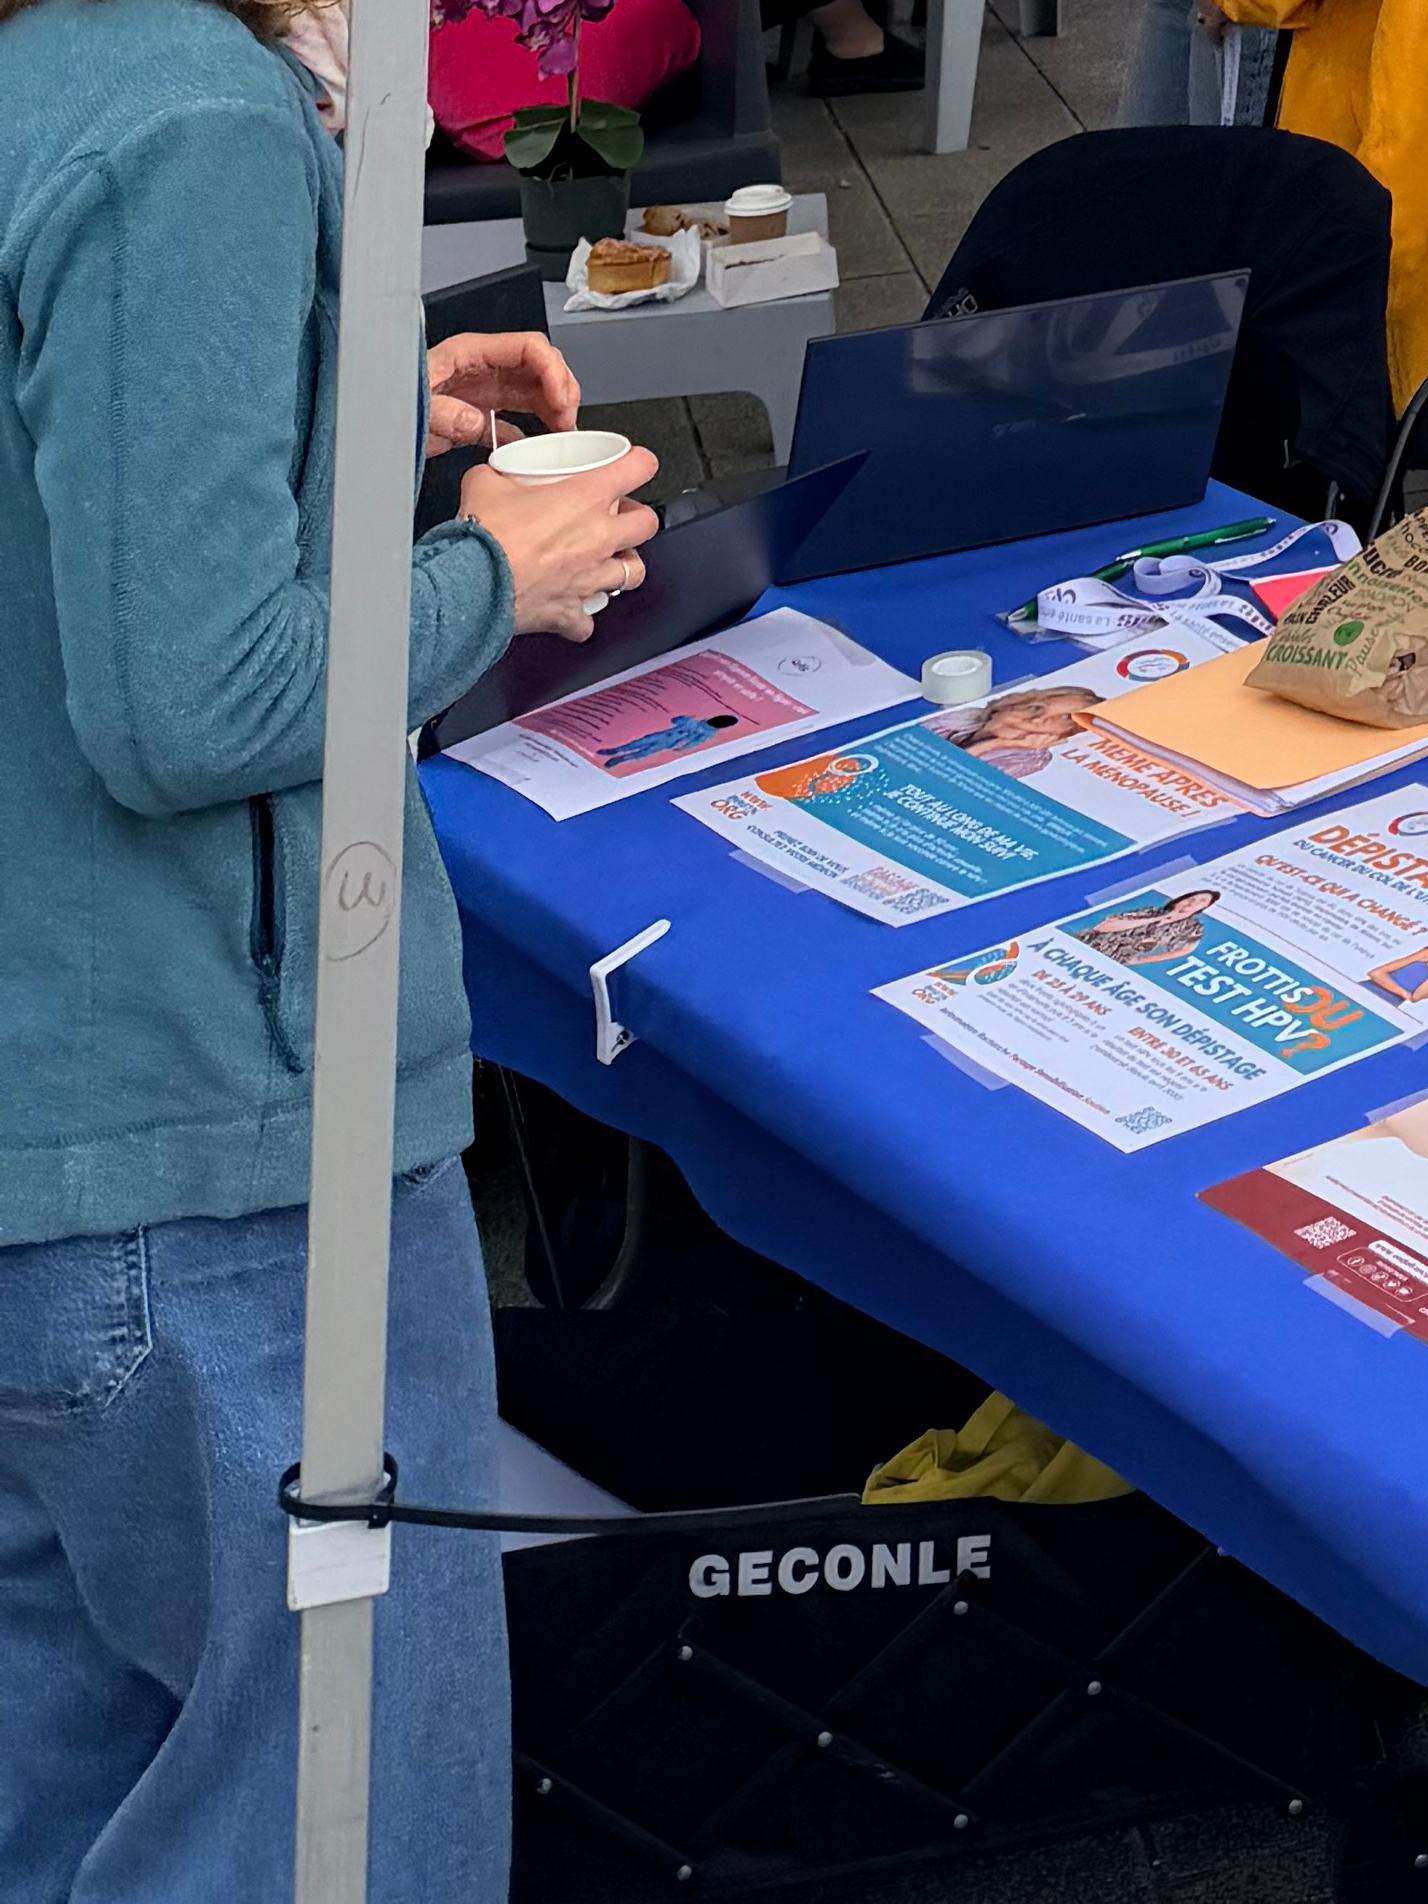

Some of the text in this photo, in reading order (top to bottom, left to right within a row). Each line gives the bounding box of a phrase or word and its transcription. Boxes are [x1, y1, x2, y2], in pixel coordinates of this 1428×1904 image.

[1267, 643, 1348, 670] CROISSANT
[1059, 746, 1089, 765] LA
[1083, 757, 1189, 814] MÉNOPAUSE
[706, 797, 750, 821] ORG
[897, 783, 937, 803] TOUT
[926, 799, 954, 812] AU
[942, 808, 988, 830] LONG
[1290, 838, 1316, 850] DU
[1307, 846, 1358, 869] CANCER
[1348, 864, 1374, 876] DU
[1363, 870, 1396, 886] COL
[1385, 880, 1411, 893] DE
[1252, 852, 1325, 887] QU'EST-CE
[1313, 881, 1350, 898] QUI
[1337, 891, 1362, 904] A
[1351, 897, 1420, 931] CHANGÉ
[1025, 938, 1055, 953] À
[1039, 946, 1114, 989] CHAQUE
[1029, 969, 1053, 982] DE
[1056, 985, 1078, 996] À
[1098, 981, 1147, 1008] ÂGE
[1158, 954, 1253, 1007] TEST
[1205, 940, 1316, 1005] FROTTIS
[1066, 990, 1091, 1004] 29
[1080, 998, 1113, 1017] ANS
[1131, 1000, 1183, 1029] SON
[1276, 984, 1368, 1034] OU
[1124, 1025, 1235, 1092] ENTRE 30 ET 65 ANS
[1169, 1022, 1268, 1082] DÉPISTAGE
[688, 1534, 992, 1599] GECONLE
